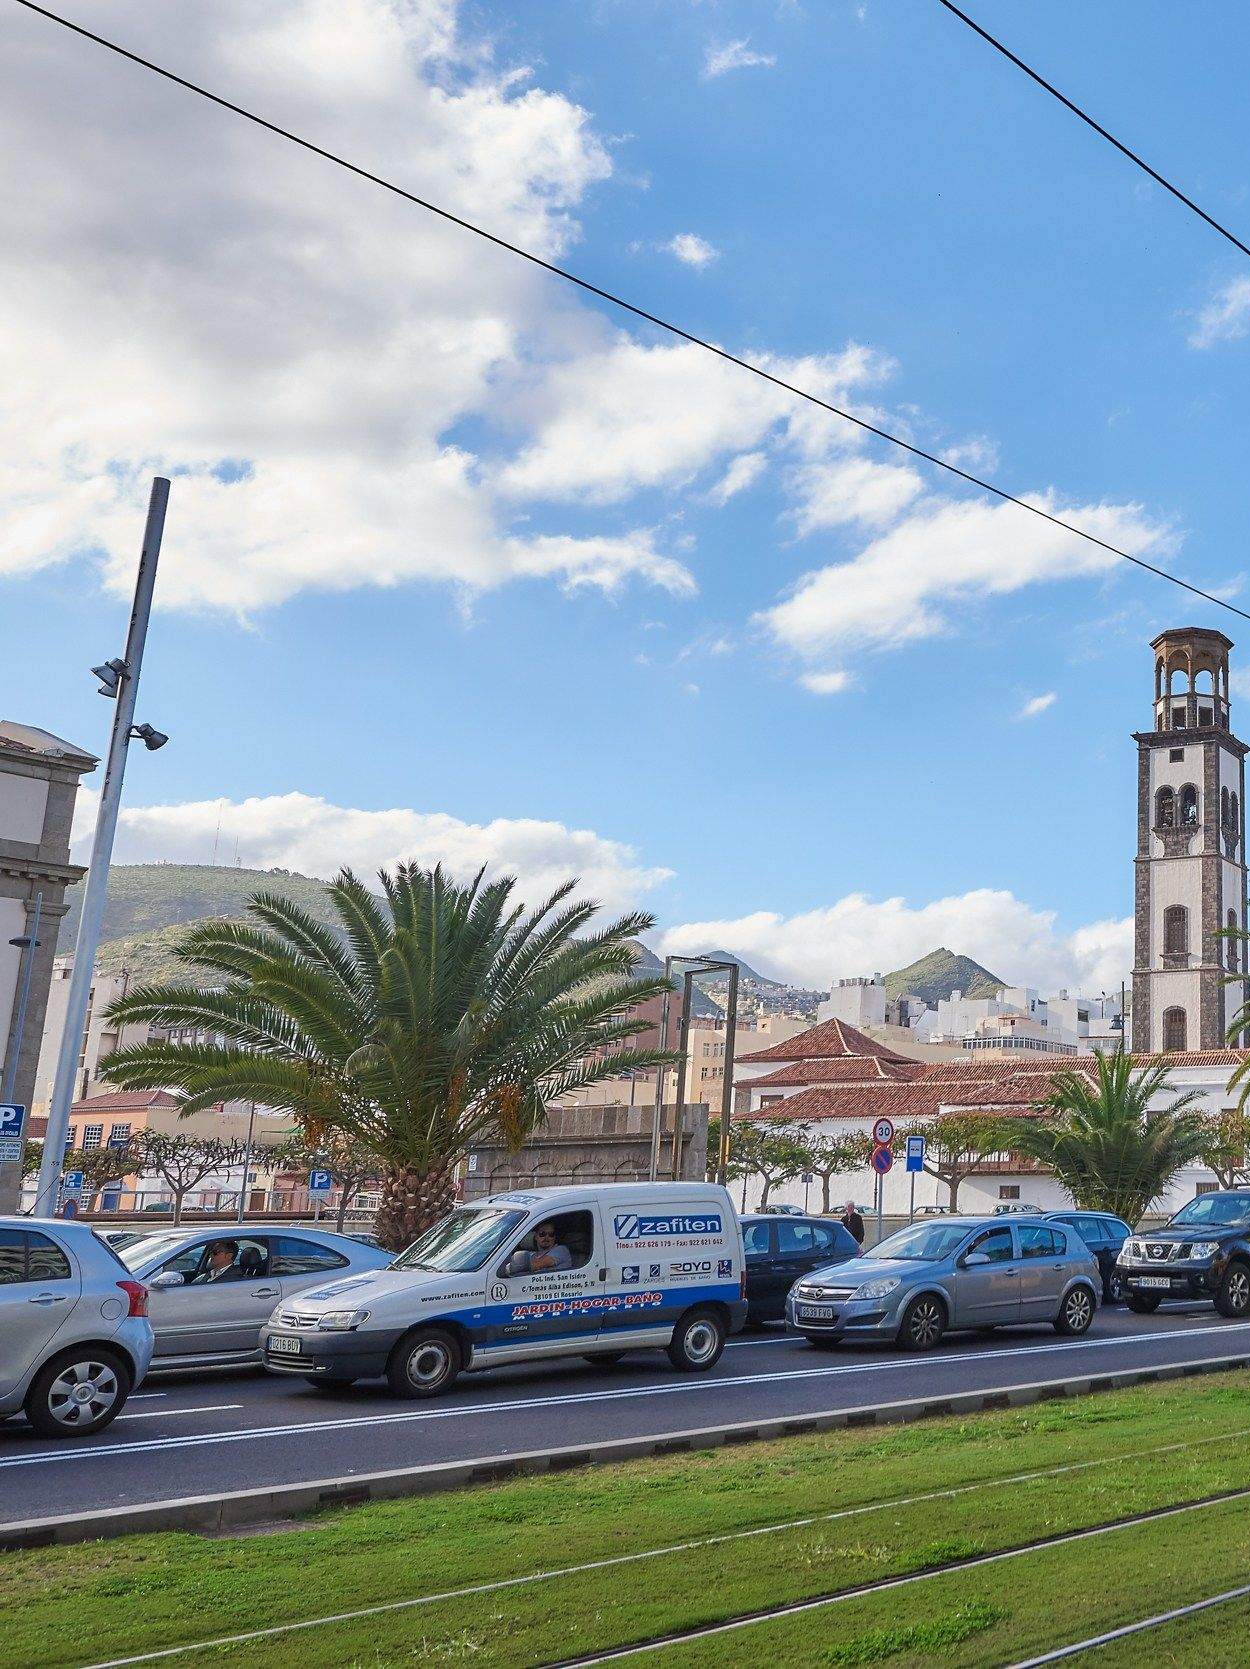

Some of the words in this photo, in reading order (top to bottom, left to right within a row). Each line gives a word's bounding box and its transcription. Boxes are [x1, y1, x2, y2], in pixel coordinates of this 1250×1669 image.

[878, 1127, 890, 1136] 30
[314, 1172, 328, 1188] P
[642, 1218, 720, 1233] zafiten
[669, 1261, 711, 1272] ROYO
[420, 1290, 485, 1302] www.zafiten.com
